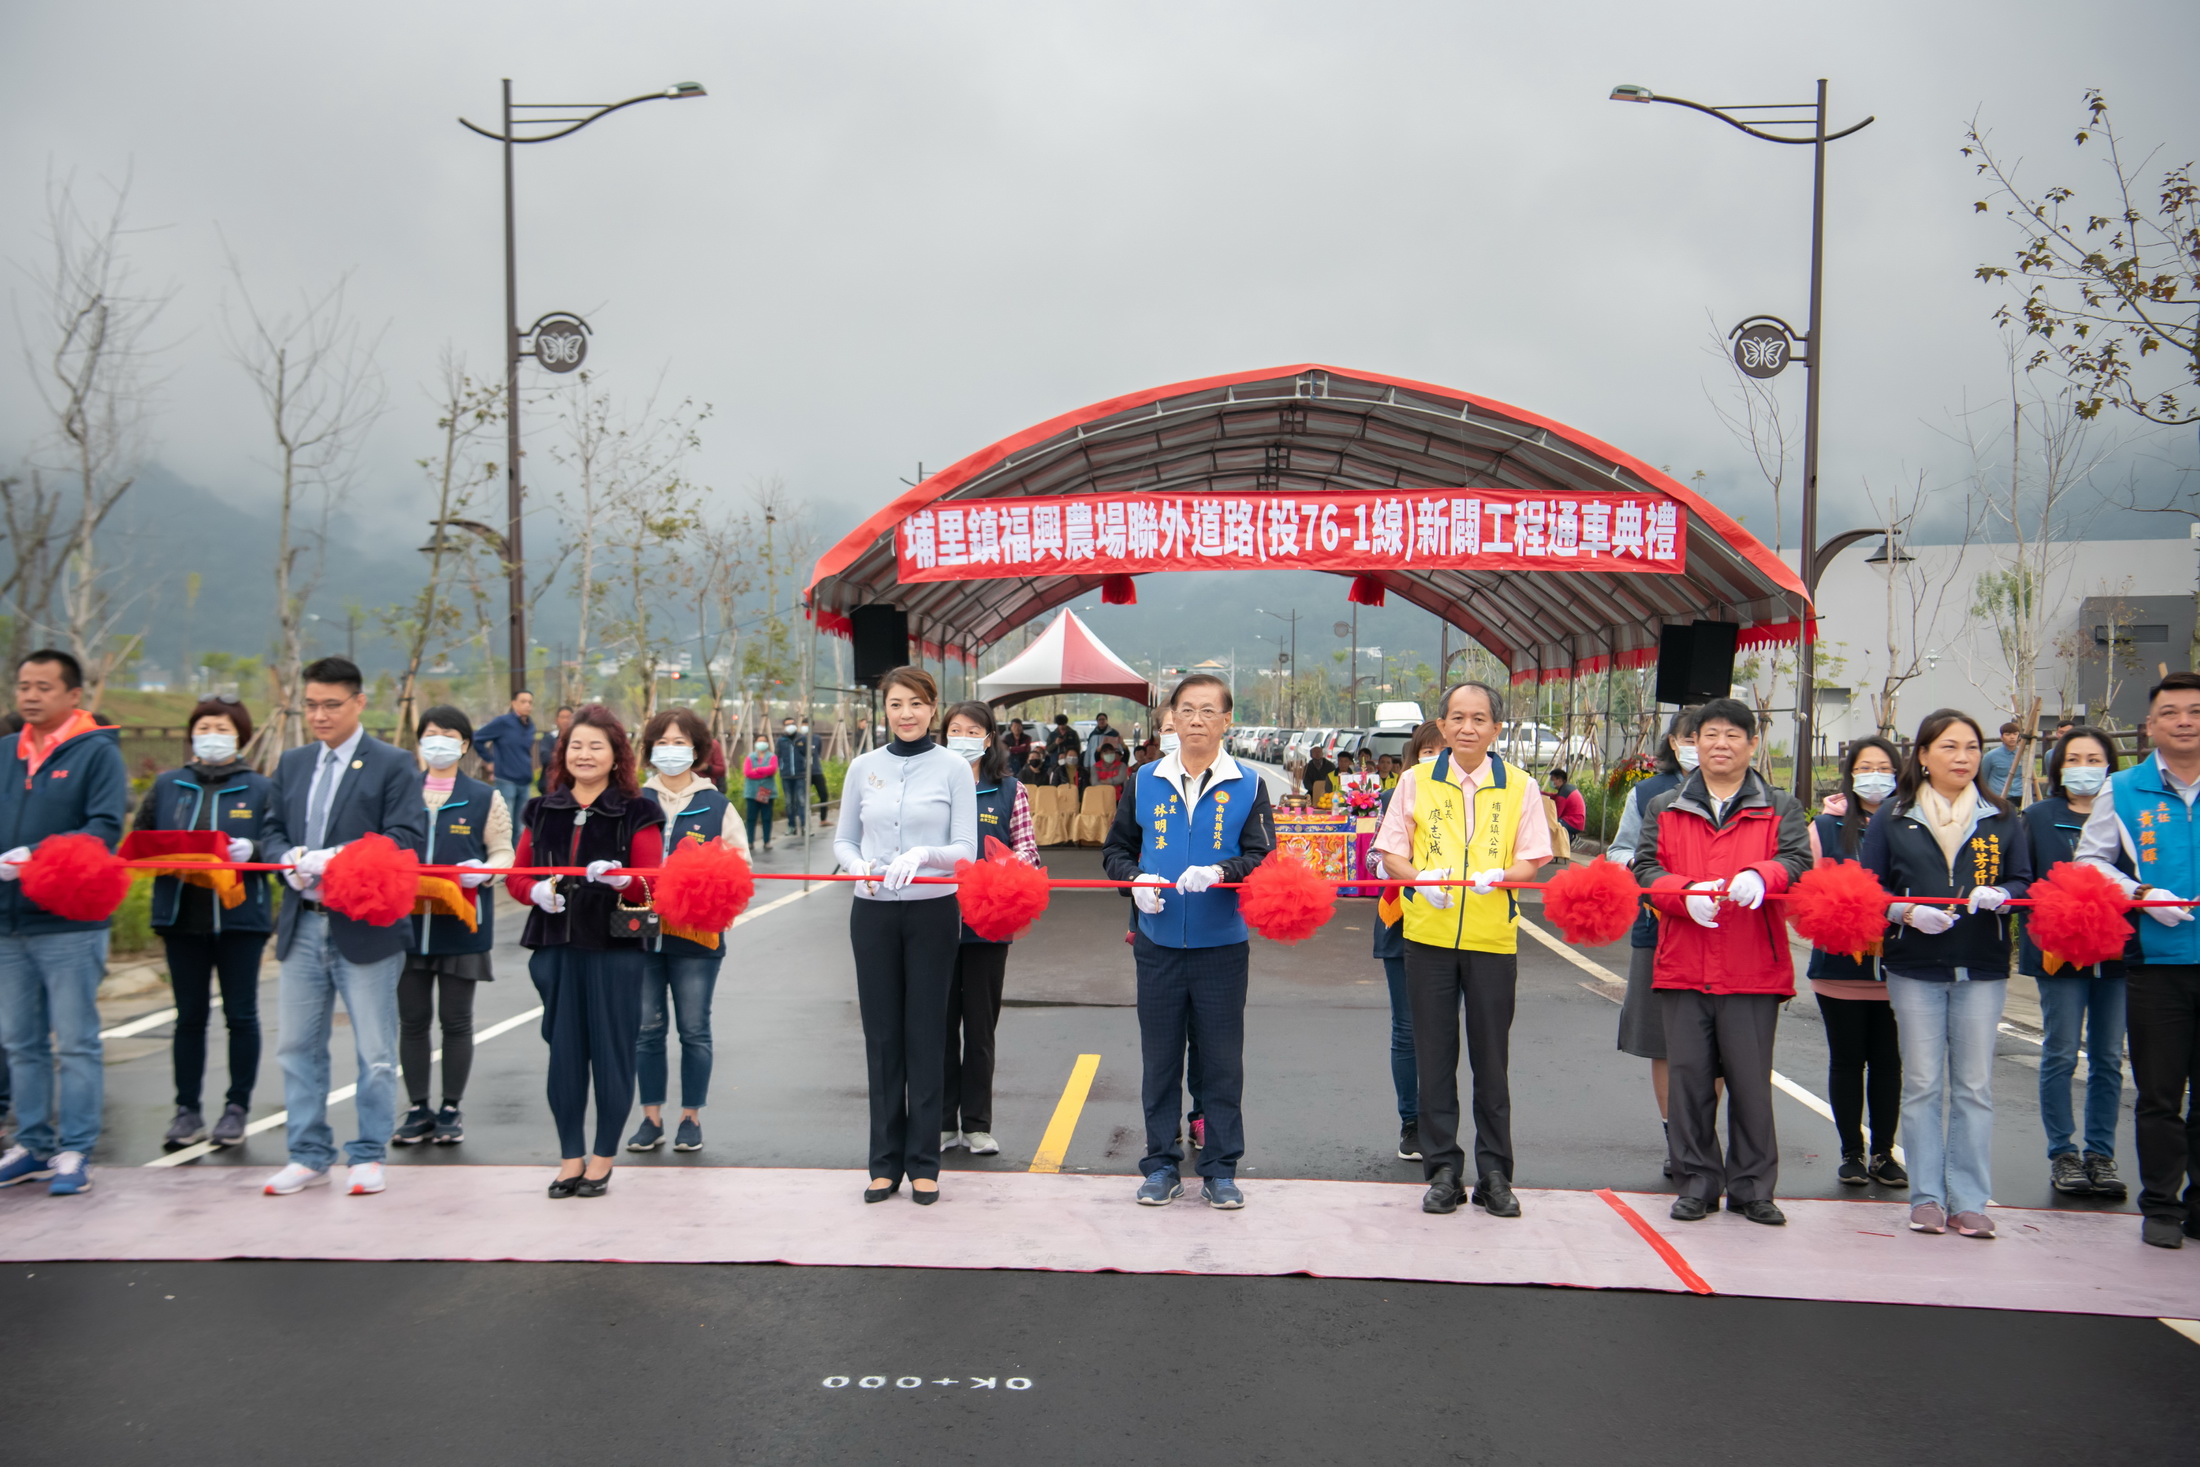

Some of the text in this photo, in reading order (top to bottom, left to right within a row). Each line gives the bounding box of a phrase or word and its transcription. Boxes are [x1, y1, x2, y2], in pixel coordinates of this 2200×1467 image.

[904, 497, 1677, 569] 埔里鎮福興農場聯外道路(投76-1線)新闢工程通車典禮
[1153, 803, 1168, 849] 林明溱
[1169, 794, 1178, 814] 縣長
[1213, 804, 1225, 849] 南投縣政府
[1445, 799, 1453, 819] 鎮長
[1428, 808, 1443, 856] 廖志城
[1488, 802, 1501, 859] 埔里鎮公所
